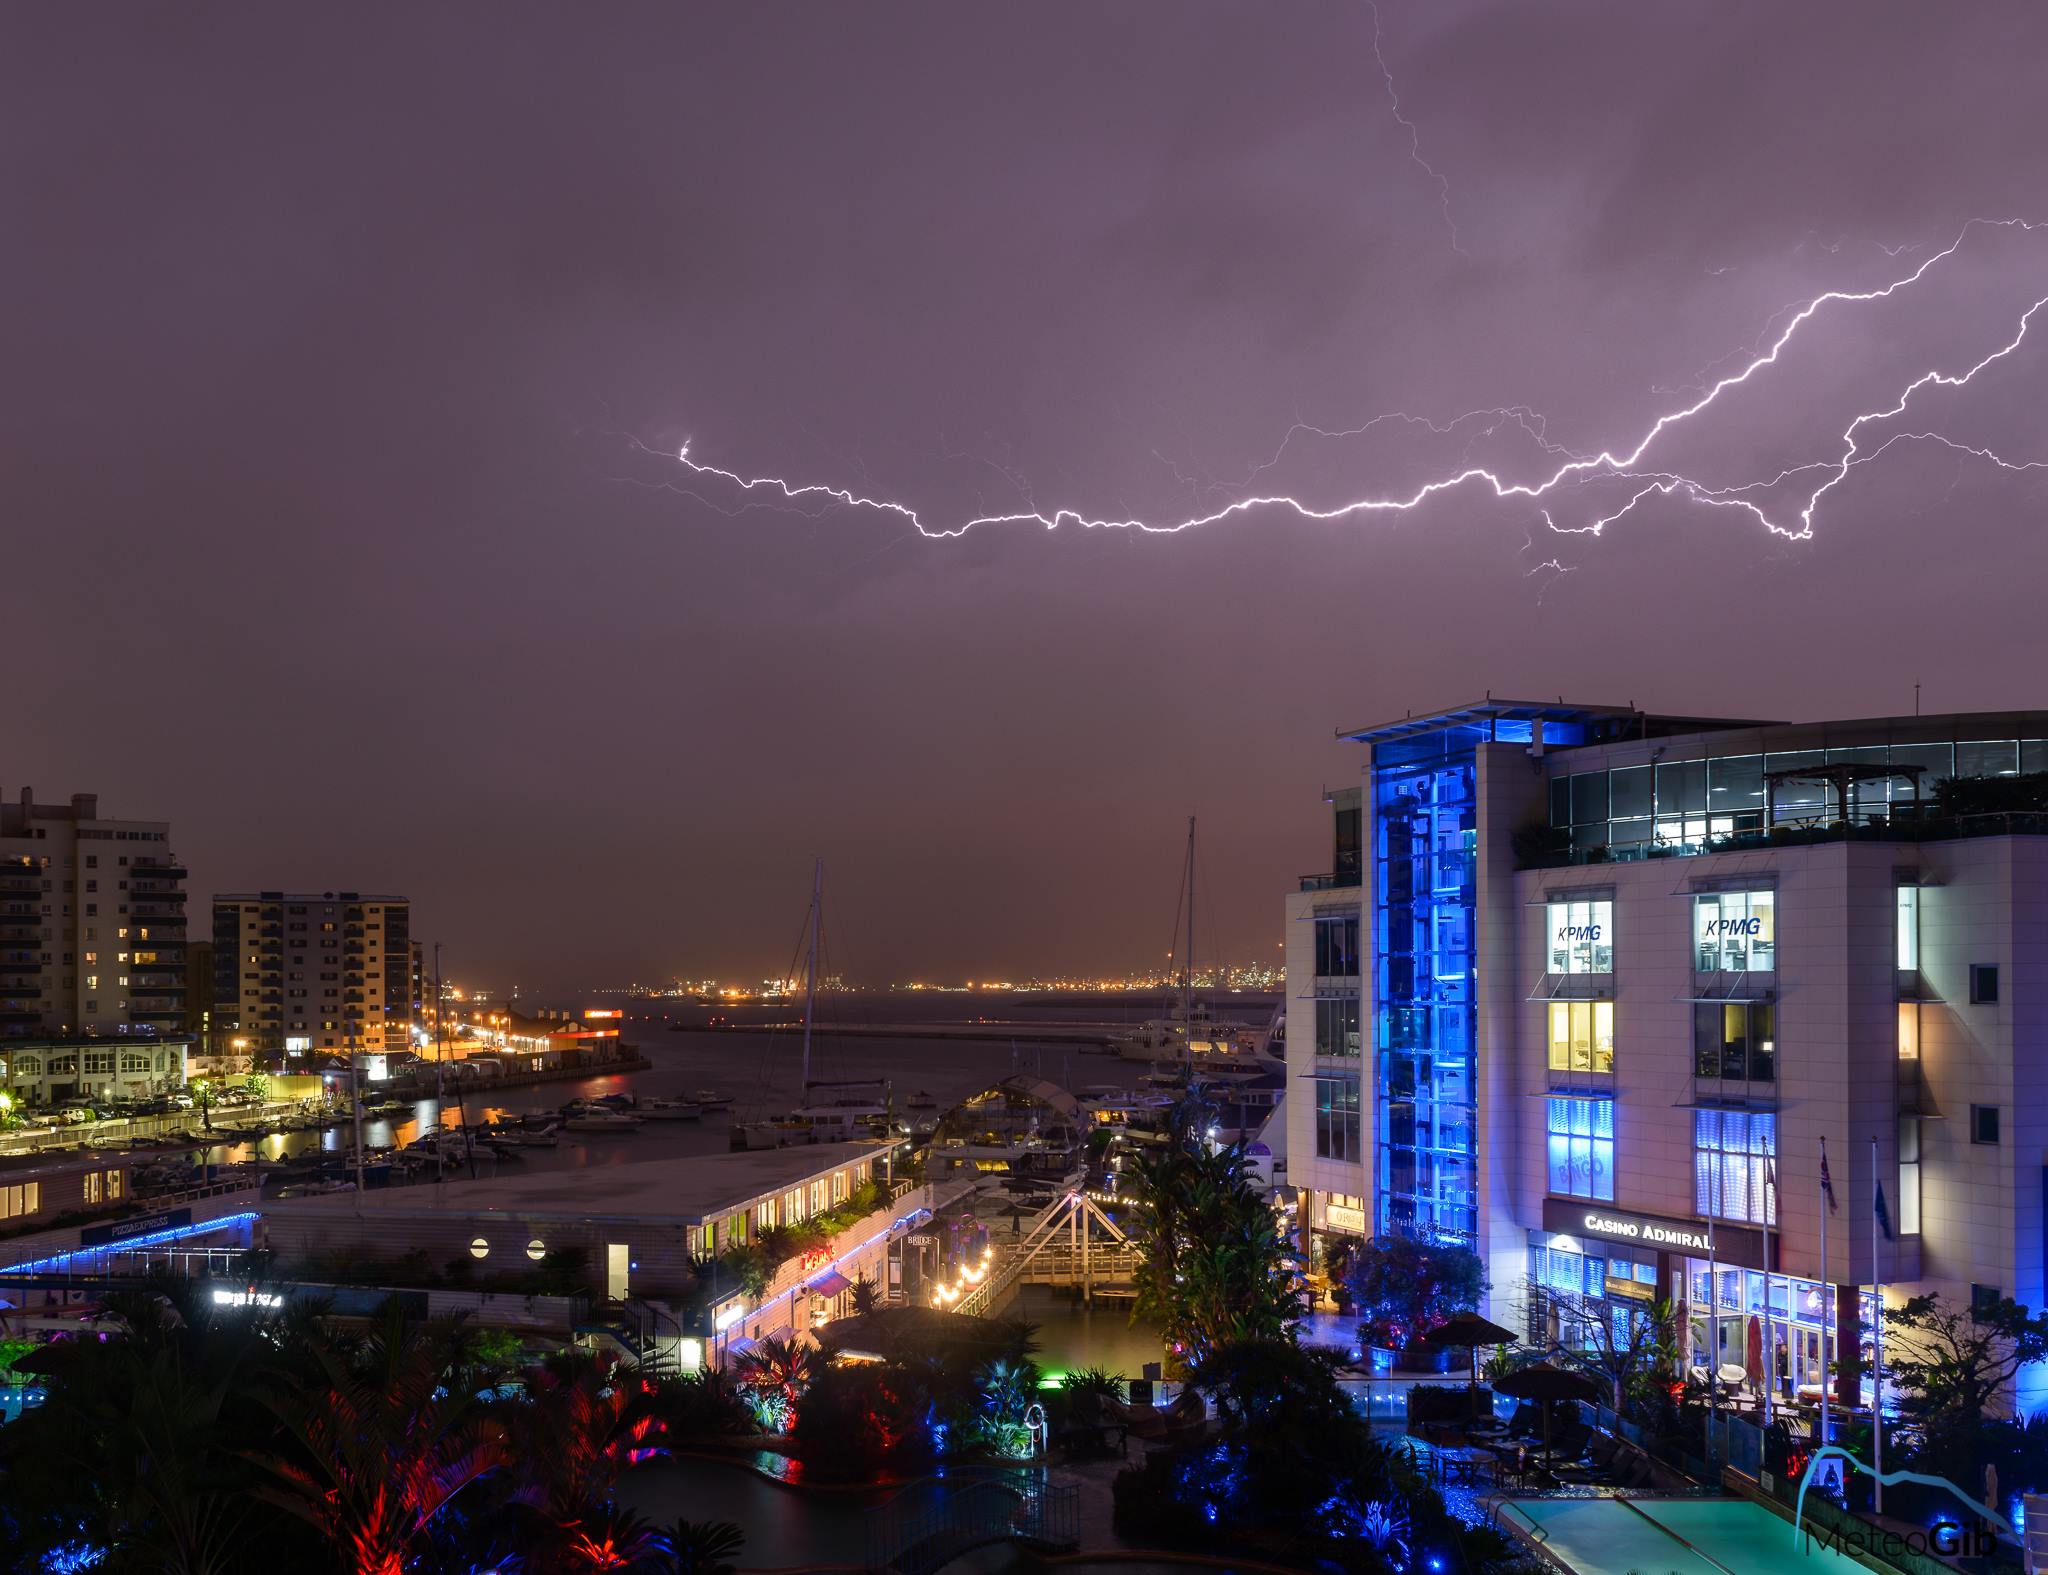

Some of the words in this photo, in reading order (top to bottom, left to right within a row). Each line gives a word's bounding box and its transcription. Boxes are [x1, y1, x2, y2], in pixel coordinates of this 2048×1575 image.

[1557, 924, 1602, 942] KPMG
[1706, 917, 1761, 936] KPMG
[1584, 1215, 1639, 1238] CASINO
[1642, 1225, 1715, 1251] ADMIRAL
